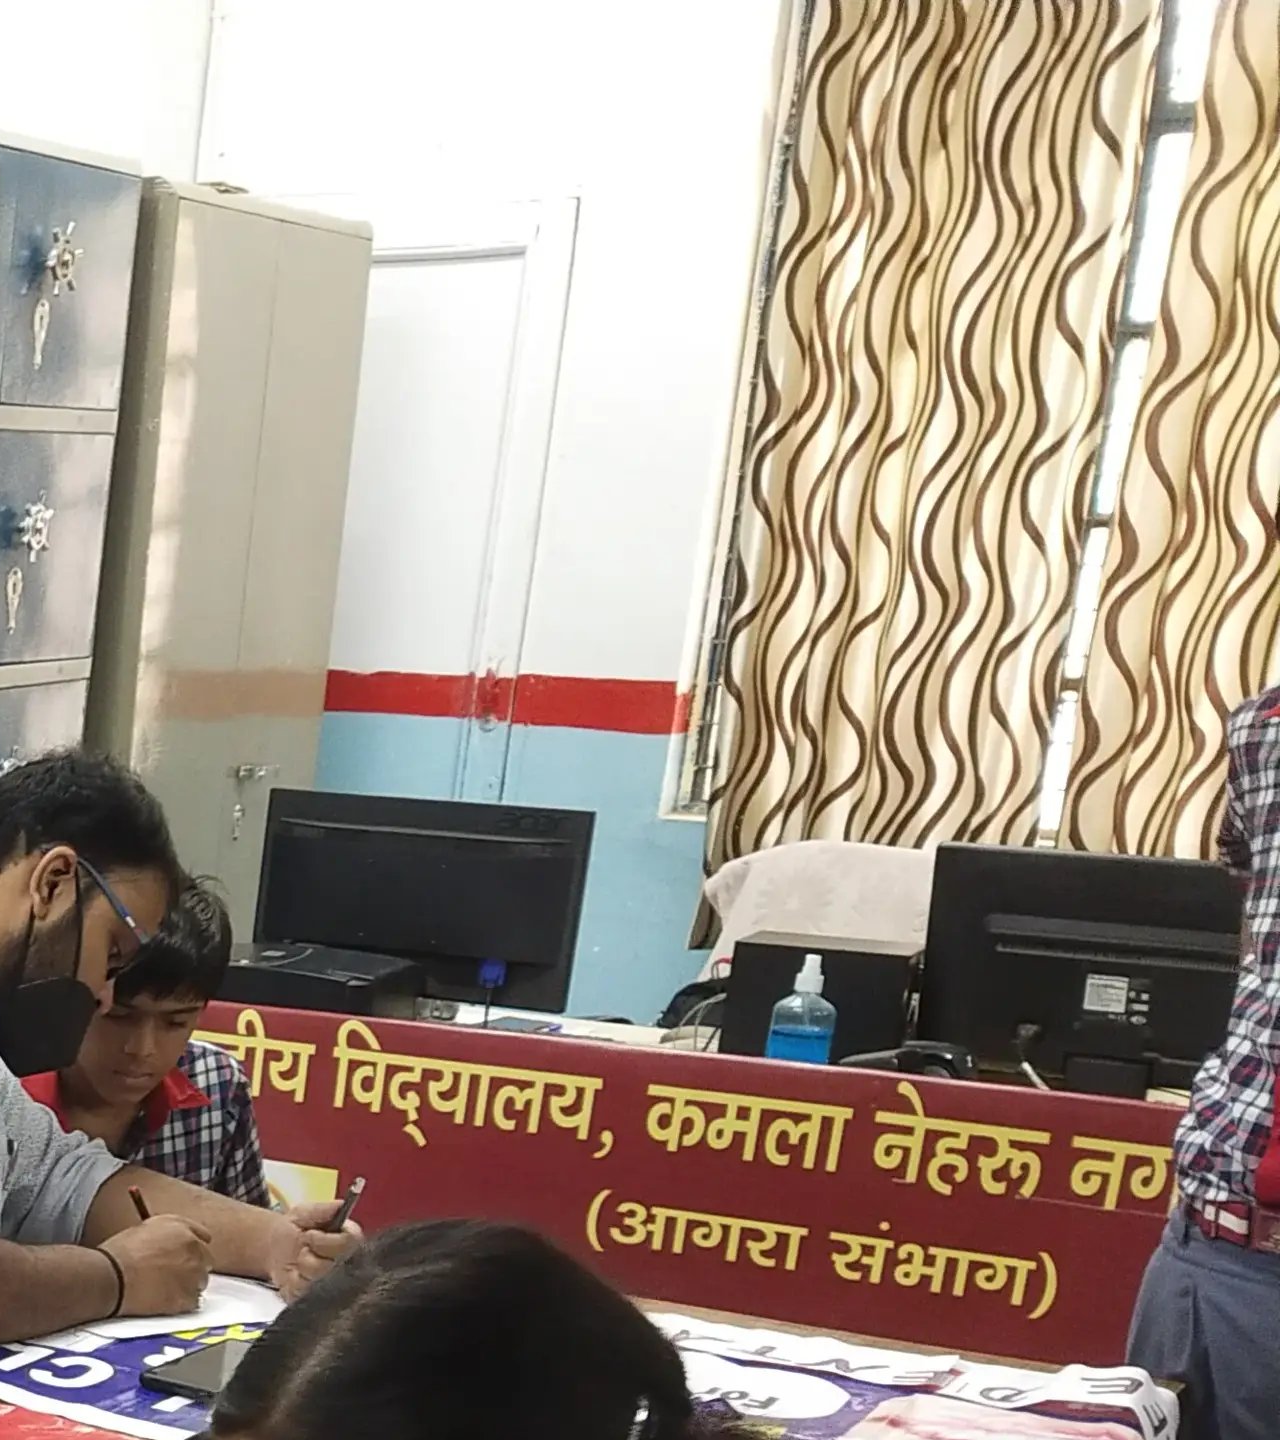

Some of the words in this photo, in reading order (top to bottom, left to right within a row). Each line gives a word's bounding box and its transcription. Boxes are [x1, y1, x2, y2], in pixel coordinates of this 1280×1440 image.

[646, 1085, 854, 1173] कमला
[872, 1081, 1051, 1199] नेहरू
[586, 1189, 809, 1271] (आगरा
[829, 1221, 1058, 1320] संभाग)
